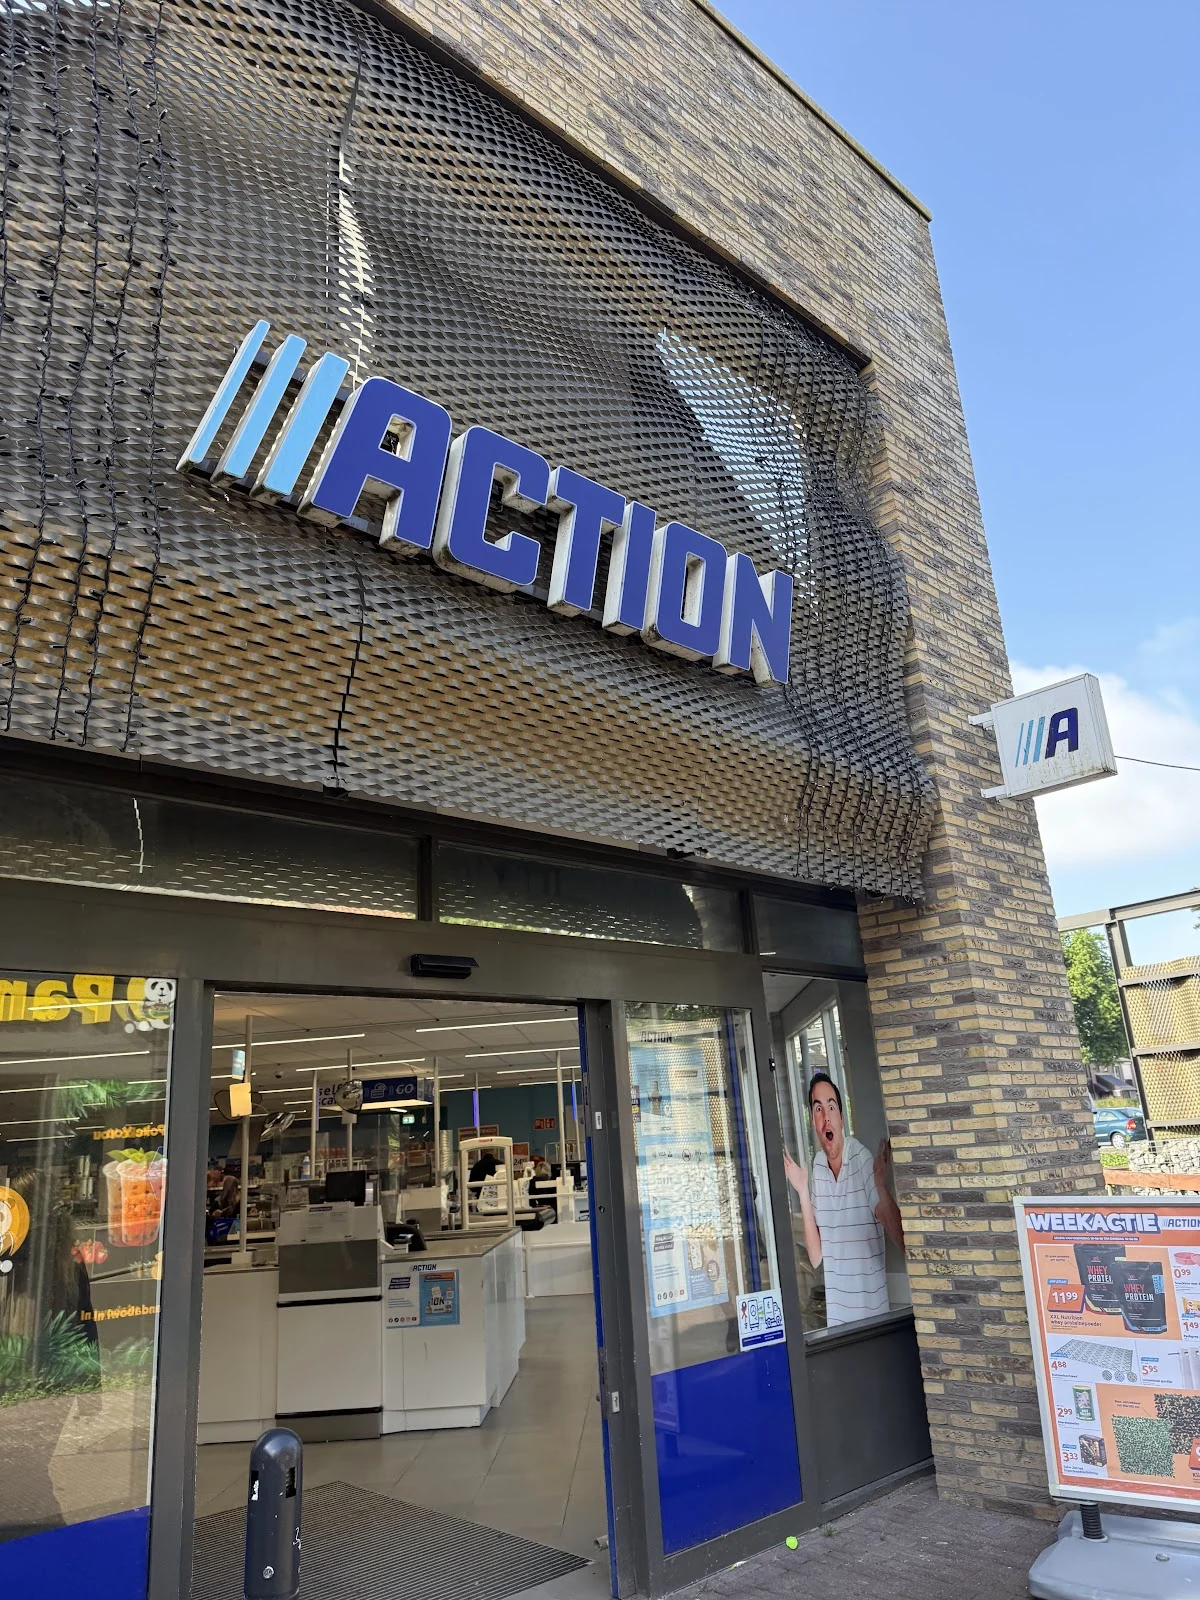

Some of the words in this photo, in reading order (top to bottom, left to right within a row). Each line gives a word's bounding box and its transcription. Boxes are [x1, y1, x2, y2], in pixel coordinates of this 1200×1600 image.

[297, 376, 793, 688] ACTION
[1045, 707, 1079, 760] A
[640, 1031, 673, 1043] ACTION
[395, 1083, 415, 1095] GO
[1029, 1212, 1161, 1234] WEEKACTIE
[412, 1264, 437, 1272] ACTION
[1087, 1265, 1108, 1275] WHEY
[1088, 1275, 1113, 1283] PROTEI
[1123, 1284, 1145, 1293] WHEY
[1125, 1293, 1154, 1301] PROTEIN
